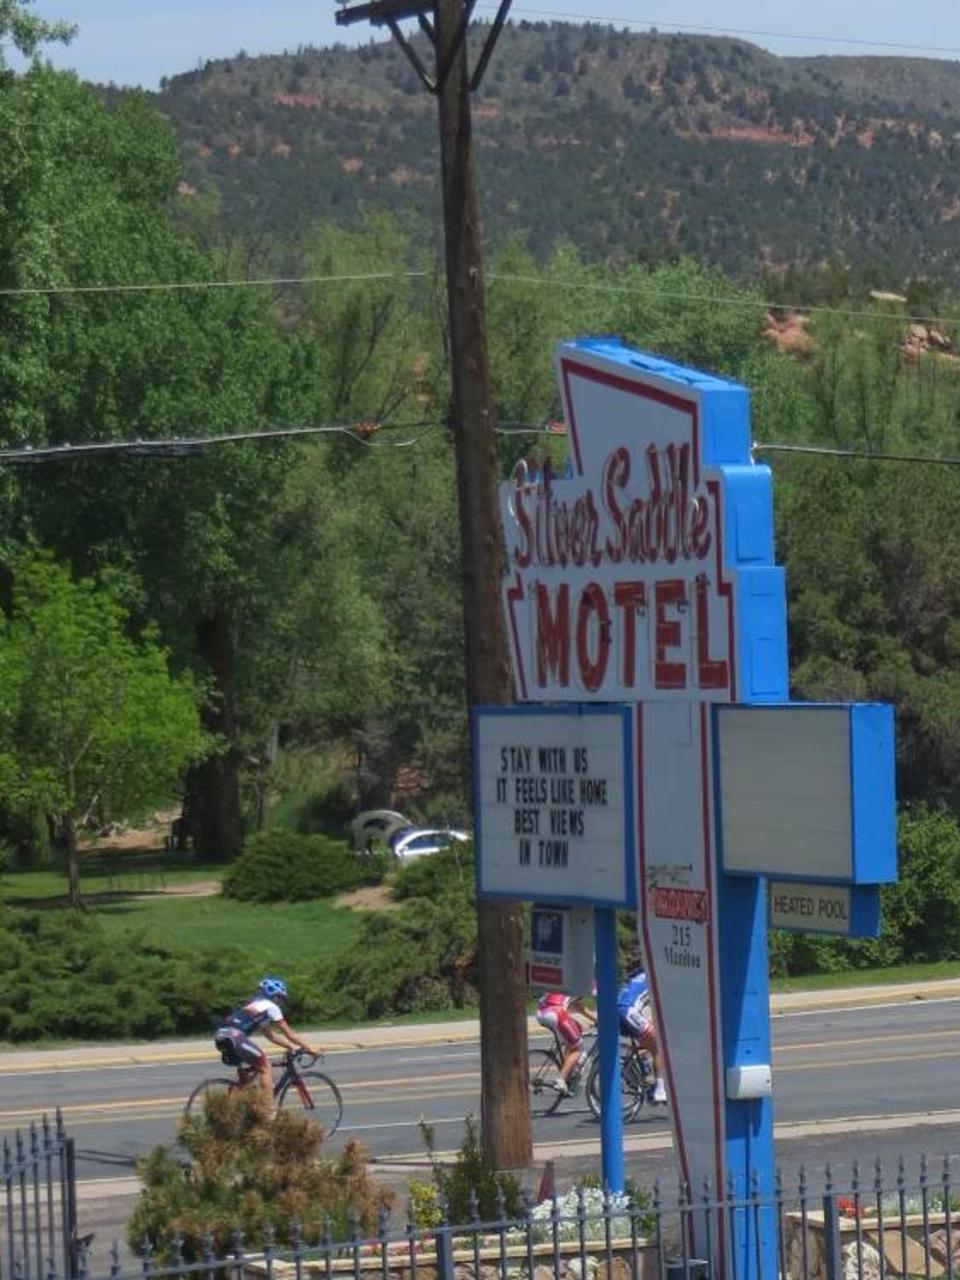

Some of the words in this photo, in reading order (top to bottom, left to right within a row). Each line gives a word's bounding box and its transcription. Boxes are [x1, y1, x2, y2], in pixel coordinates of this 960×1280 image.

[508, 458, 601, 568] Silver
[605, 442, 711, 564] Saddle
[536, 579, 728, 691] MOTEL
[501, 747, 531, 773] STAY
[538, 747, 566, 773] WITH
[573, 747, 588, 773] US
[497, 778, 507, 803] IT
[515, 778, 547, 804] FEELS
[550, 779, 575, 804] LIKE
[580, 779, 607, 806] HOME
[514, 809, 539, 835] BEST
[550, 809, 584, 837] VIEWS
[519, 840, 530, 866] IN
[538, 840, 568, 868] TOWN
[773, 895, 814, 916] HEATED
[819, 898, 847, 920] POOL
[671, 925, 692, 947] 215
